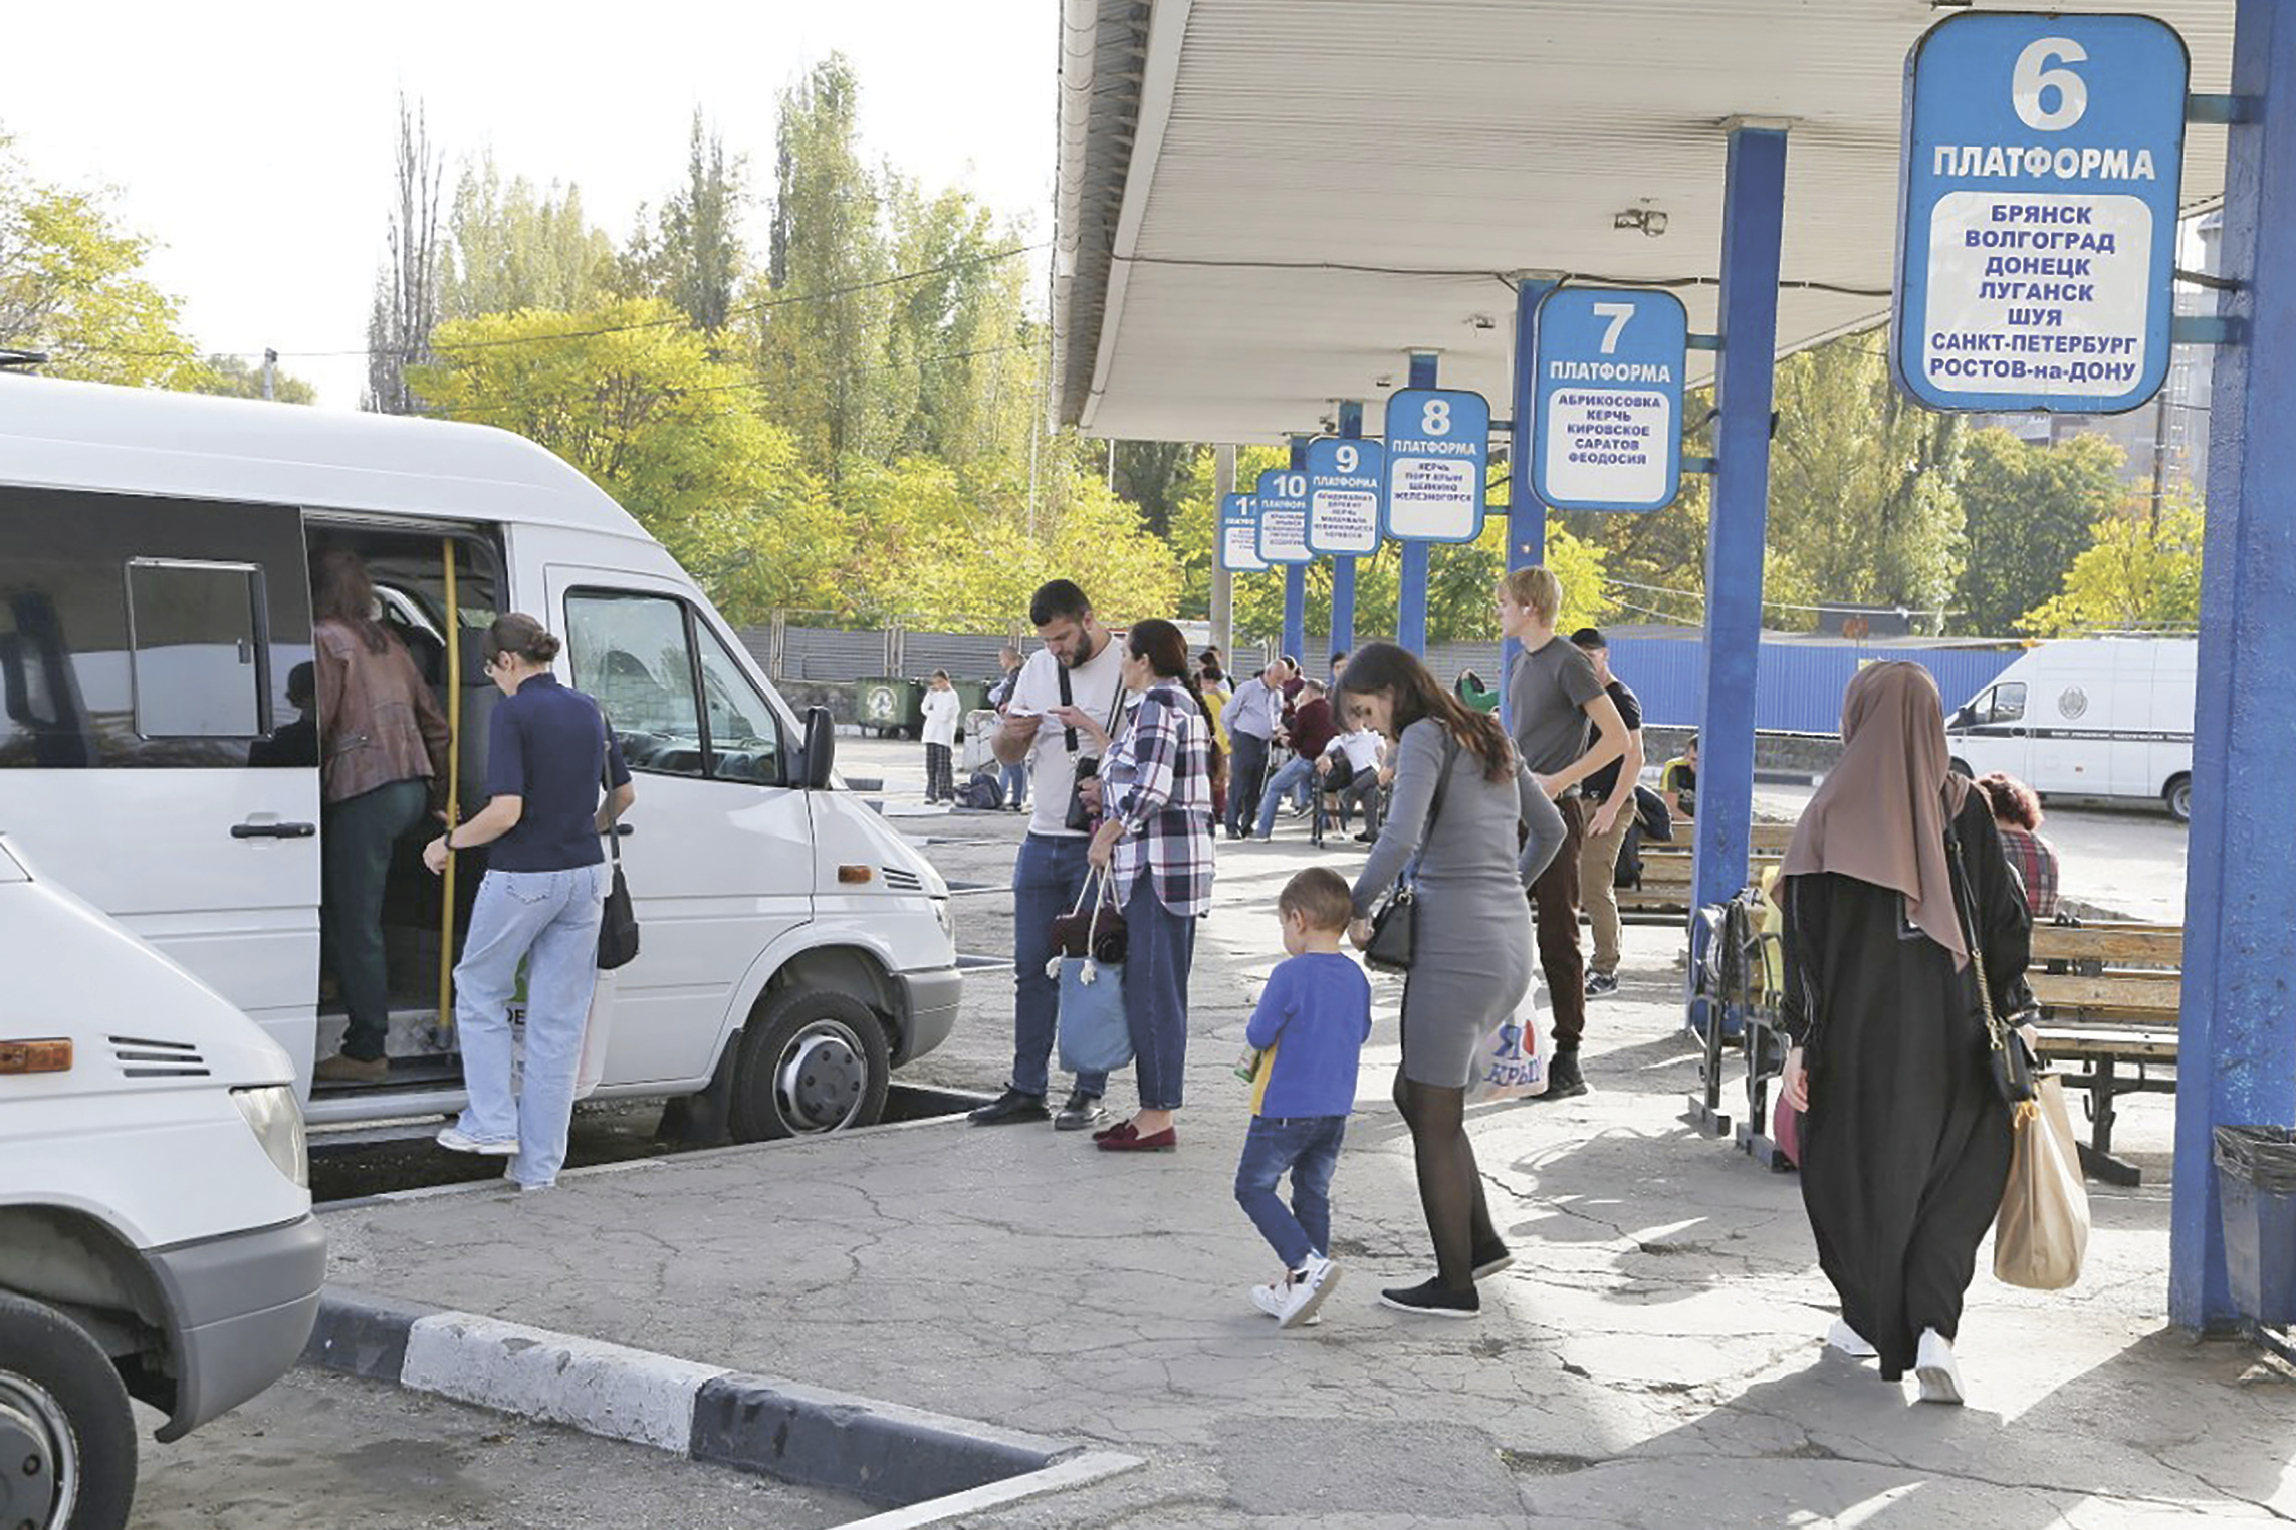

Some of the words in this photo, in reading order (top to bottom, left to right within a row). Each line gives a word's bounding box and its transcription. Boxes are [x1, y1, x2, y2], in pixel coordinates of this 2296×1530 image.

[2012, 37, 2089, 131] 6
[1933, 146, 2156, 180] ПЛАТФОРМА
[1991, 204, 2092, 225] БРЯНСК
[1964, 230, 2115, 253] ВОЛГОГРАД
[1985, 257, 2091, 278] ДОНЕЦК
[1979, 282, 2094, 302] ЛУГАНСК
[1593, 302, 1635, 354] 7
[2008, 308, 2062, 327] ШУЯ
[1931, 332, 2137, 355] САНКТ-ПЕТЕРБУРГ
[1550, 361, 1670, 383] ПЛАТФОРМА
[1929, 358, 2136, 383] РОСТОВ-на-ДОНУ
[1558, 395, 1661, 408] АБРИКОСОВКА
[1421, 399, 1450, 436] 8
[1586, 410, 1632, 422] КЕРЧЬ
[1567, 423, 1650, 437] КИРОВСКОЕ
[1393, 440, 1477, 456] ПЛАТФОРМА
[1575, 438, 1639, 451] САРАТОВ
[1335, 445, 1359, 474] 9
[1568, 452, 1647, 466] ФЕОДОСИЯ
[1273, 475, 1306, 498] 10
[1313, 476, 1378, 488] ПЛАТФОРМА
[1491, 1024, 1522, 1060] Я
